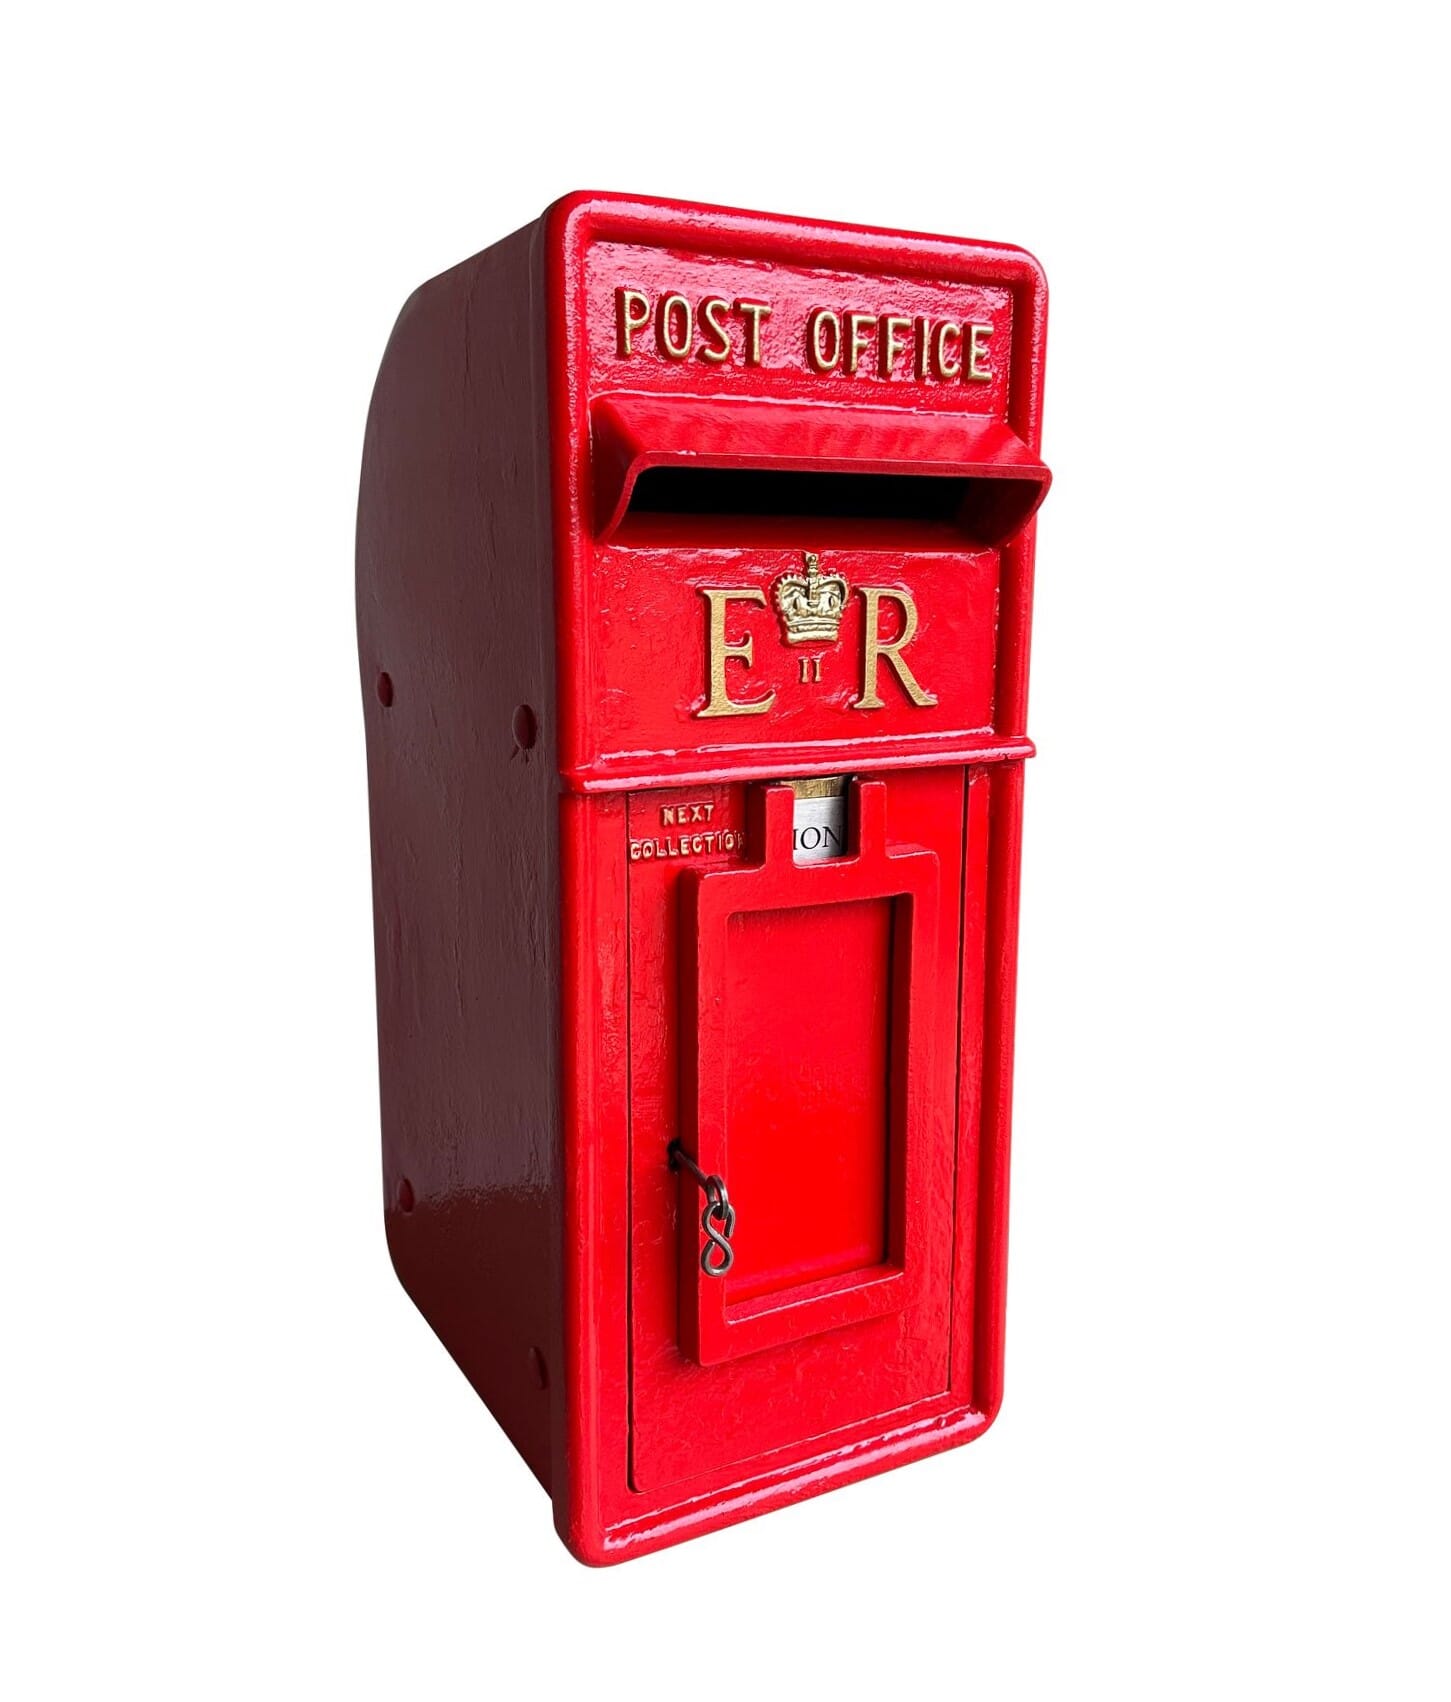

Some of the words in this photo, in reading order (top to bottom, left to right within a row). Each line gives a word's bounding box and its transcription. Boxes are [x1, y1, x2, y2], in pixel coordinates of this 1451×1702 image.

[617, 288, 772, 366] POST
[809, 308, 994, 381] OFFICE
[696, 588, 777, 718] E
[853, 587, 939, 709] R
[800, 659, 822, 683] II
[662, 804, 714, 826] NEXT
